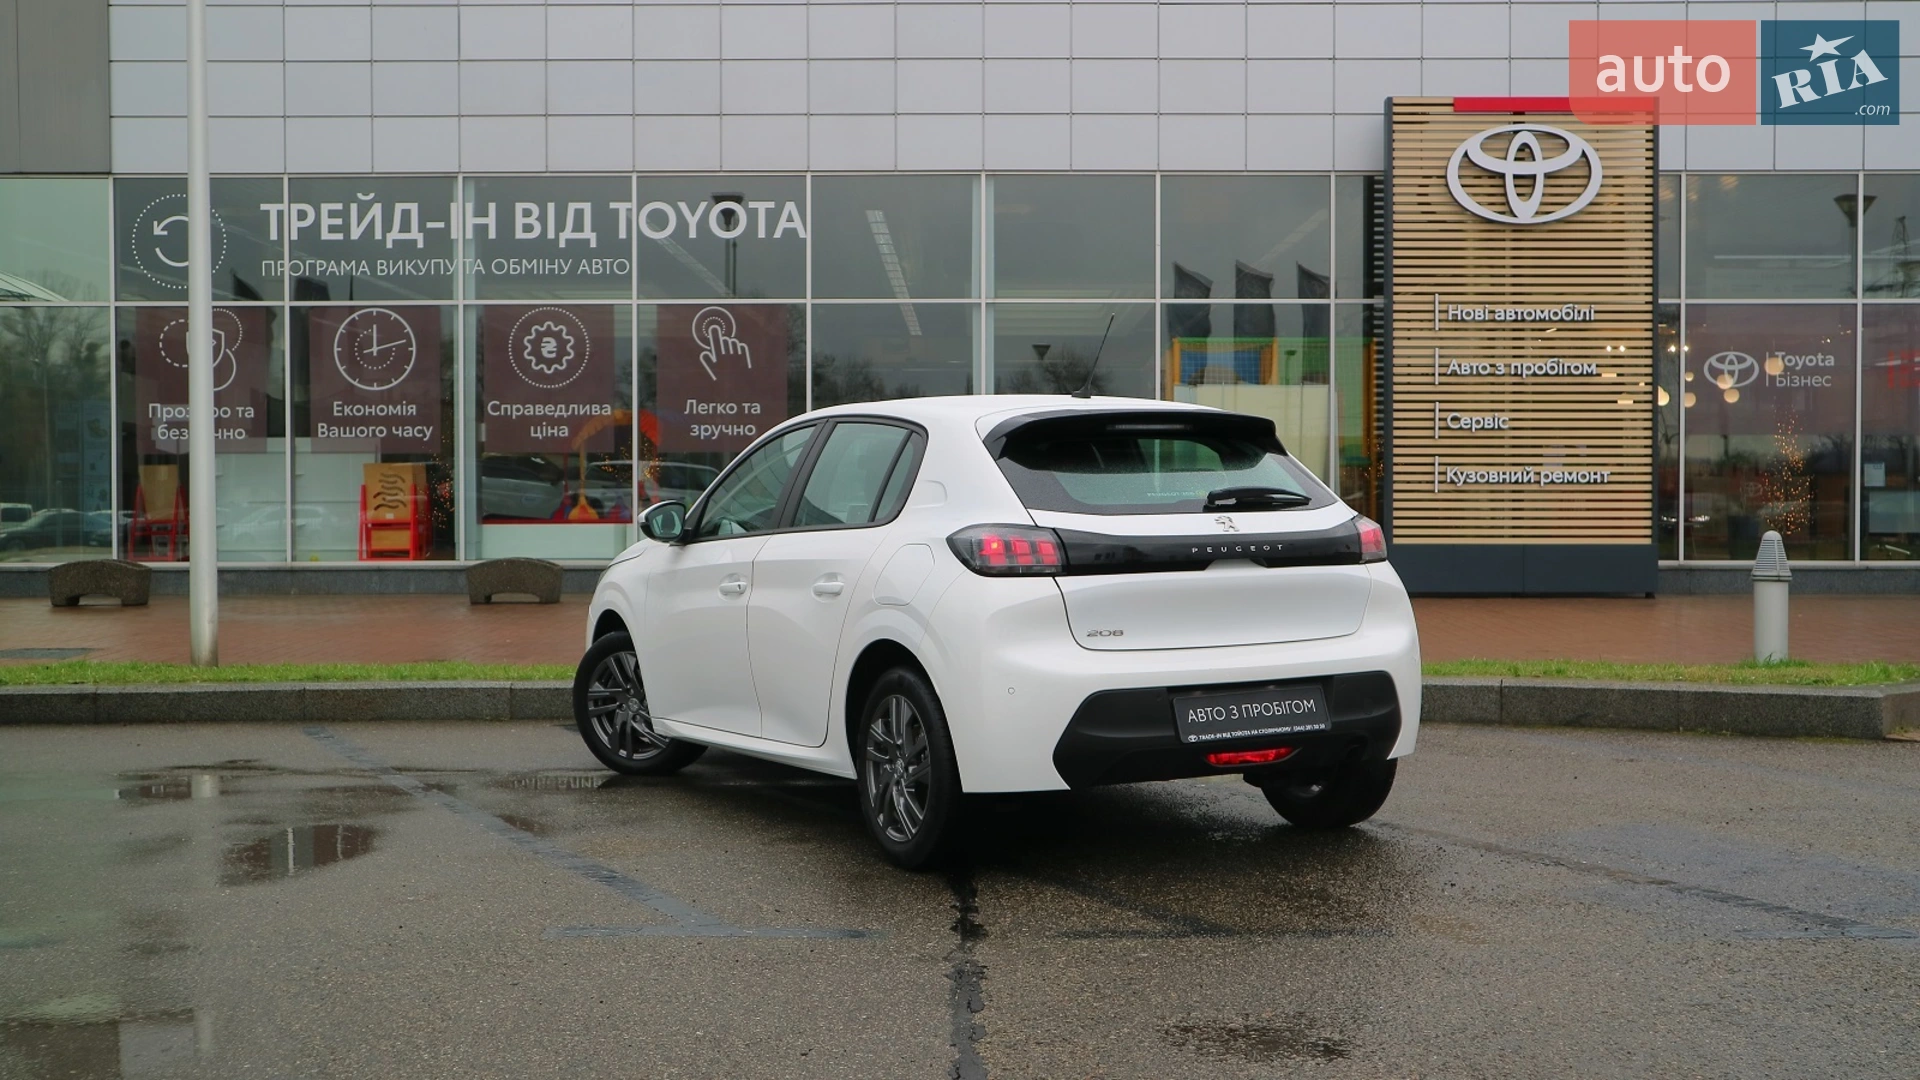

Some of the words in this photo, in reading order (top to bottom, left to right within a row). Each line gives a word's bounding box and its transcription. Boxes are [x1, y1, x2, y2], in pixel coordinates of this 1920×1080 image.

[260, 193, 497, 249] ТРЕЙД-ІН
[514, 201, 597, 248] ВІД
[609, 201, 807, 239] TOYOTA
[262, 259, 370, 276] ПРОГРАМА
[377, 259, 457, 276] ВИКУПУ
[461, 258, 485, 275] ТА
[492, 258, 572, 275] ОБМІНУ
[577, 258, 630, 275] АВТО
[1448, 304, 1489, 321] Нові
[1494, 304, 1595, 321] автомобілі
[1447, 358, 1490, 375] Авто
[1495, 363, 1505, 375] з
[1510, 358, 1597, 379] пробігом
[1775, 352, 1835, 370] Toyota
[1776, 371, 1832, 387] Бізнес
[236, 407, 254, 418] та
[333, 401, 417, 416] Економія
[487, 400, 612, 419] Справедлива
[684, 399, 737, 415] Легко
[742, 402, 761, 414] та
[530, 421, 569, 439] ціна
[1446, 412, 1509, 432] Сервіс
[157, 424, 246, 440] безчно
[317, 422, 387, 438] Вашого
[392, 425, 433, 441] часу
[690, 424, 756, 439] зручно
[1446, 466, 1535, 487] Кузовний
[1540, 470, 1611, 487] ремонт
[1191, 544, 1283, 554] PEUGEOT
[1086, 629, 1124, 637] 208
[1188, 706, 1226, 723] АВТО
[1242, 699, 1317, 719] ПРОБІГОМ
